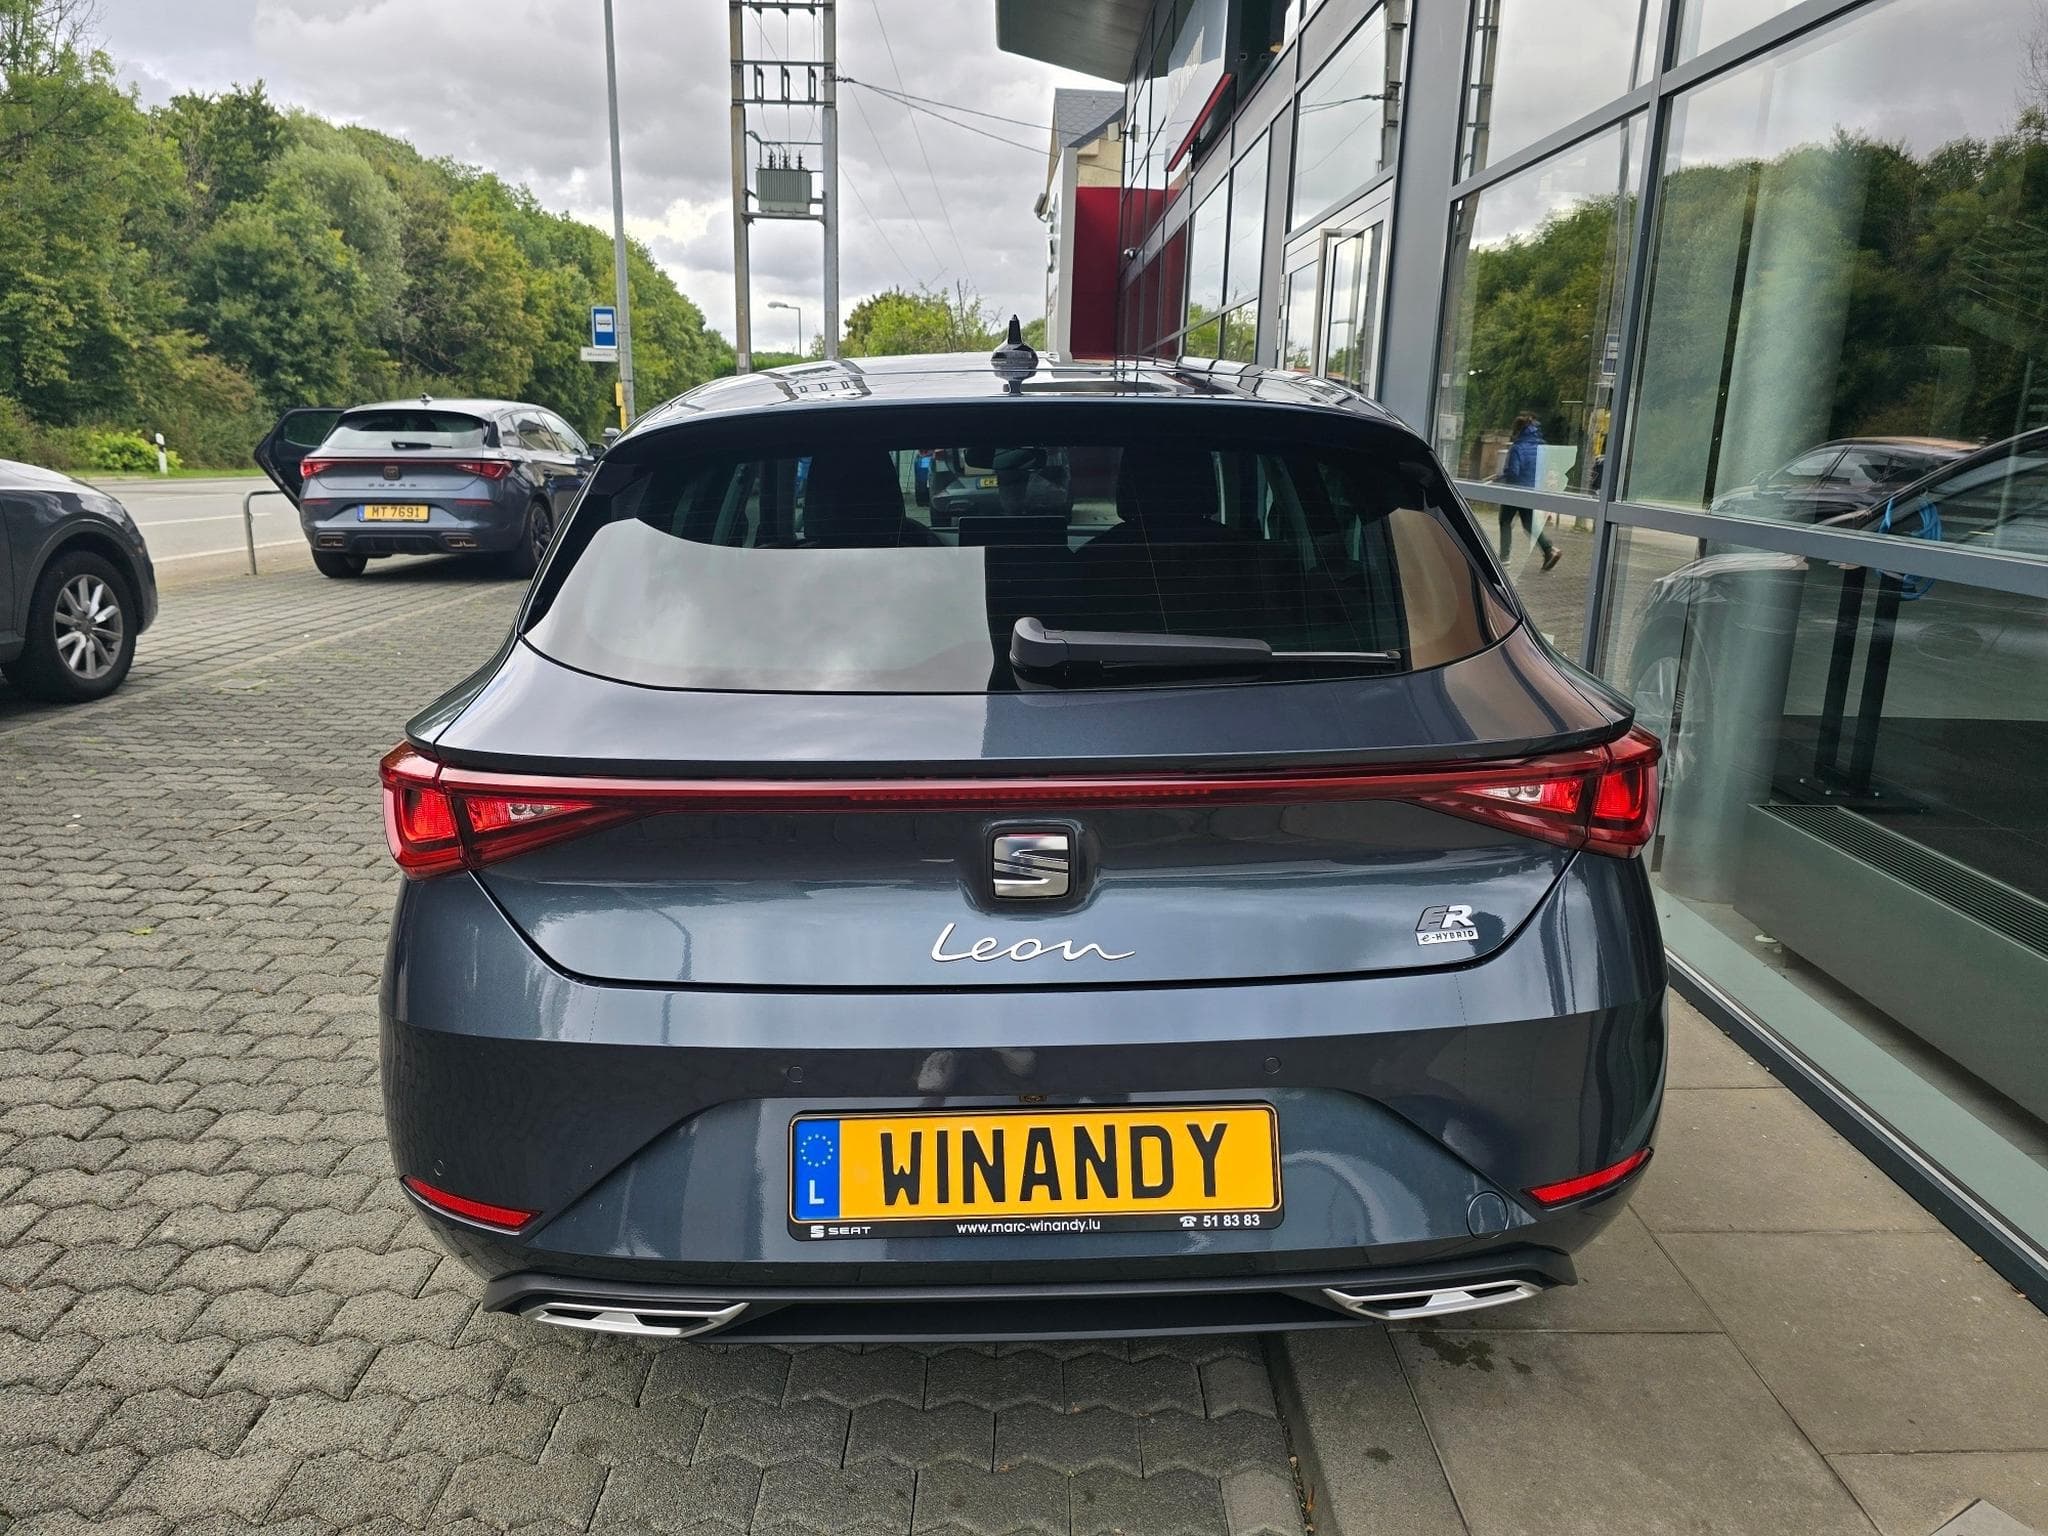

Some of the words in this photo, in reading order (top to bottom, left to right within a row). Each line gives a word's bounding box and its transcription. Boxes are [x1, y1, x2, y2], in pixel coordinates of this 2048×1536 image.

[390, 506, 420, 518] 7691
[931, 922, 1136, 962] Leon
[880, 1123, 1228, 1206] WINANDY
[808, 1179, 825, 1205] L
[956, 1218, 1101, 1234] www.marc-winandy.lu
[1203, 1215, 1219, 1227] 51
[1223, 1214, 1240, 1226] 83
[1243, 1214, 1260, 1226] 83
[828, 1226, 872, 1235] SEAT
